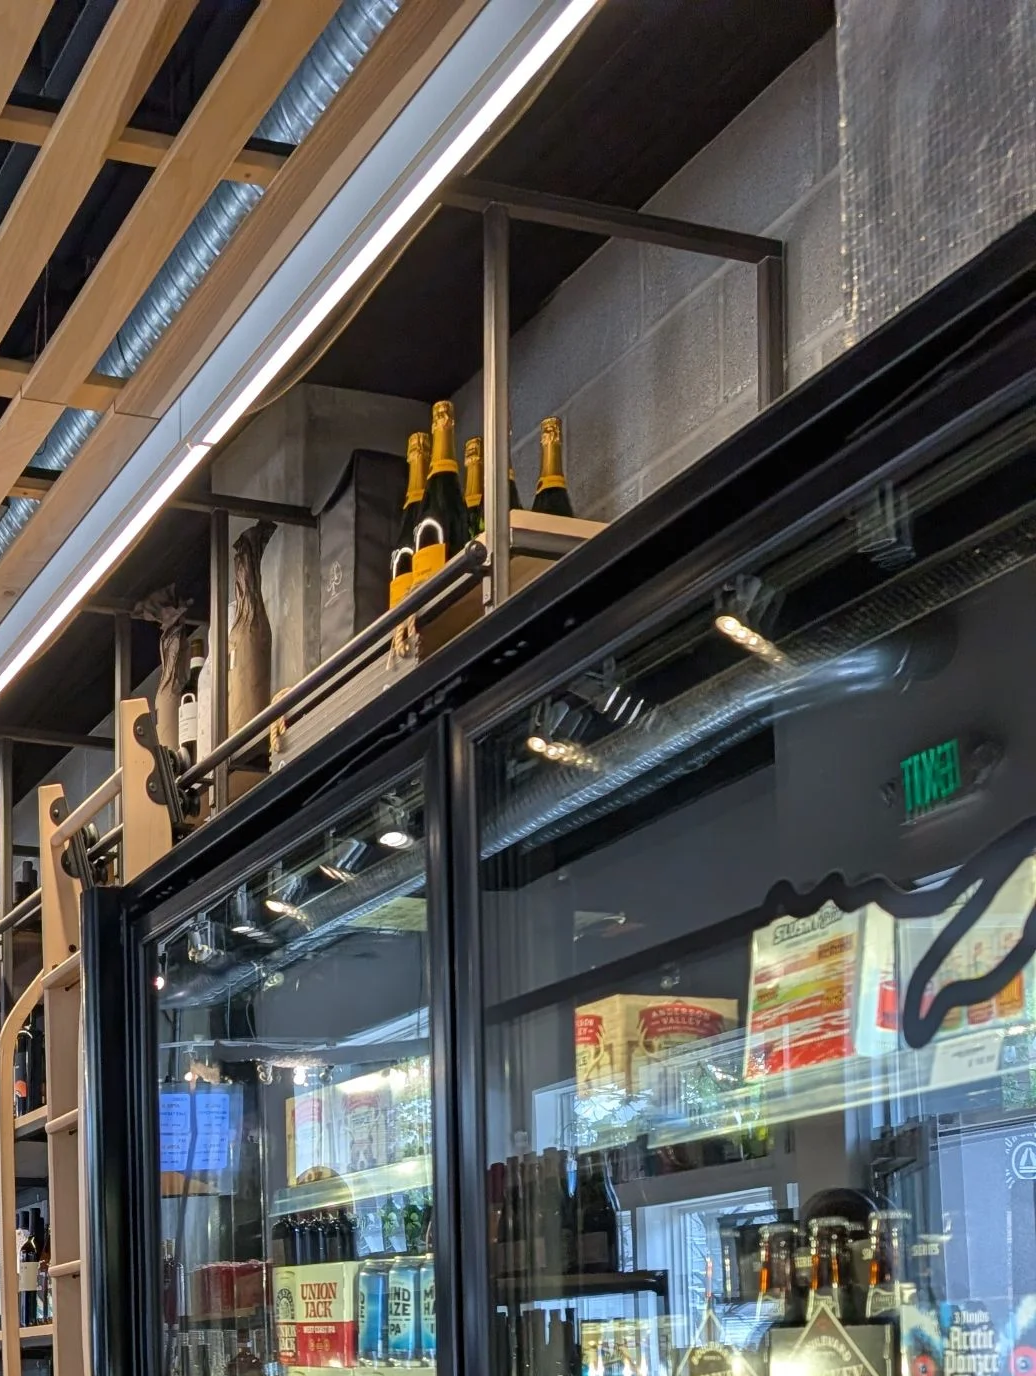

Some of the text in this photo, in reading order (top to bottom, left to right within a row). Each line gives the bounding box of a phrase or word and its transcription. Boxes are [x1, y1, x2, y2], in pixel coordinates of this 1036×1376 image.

[651, 1007, 711, 1021] ANDERSON
[663, 1017, 702, 1026] VALLEY
[300, 1282, 338, 1300] UNION
[305, 1301, 333, 1319] JACK
